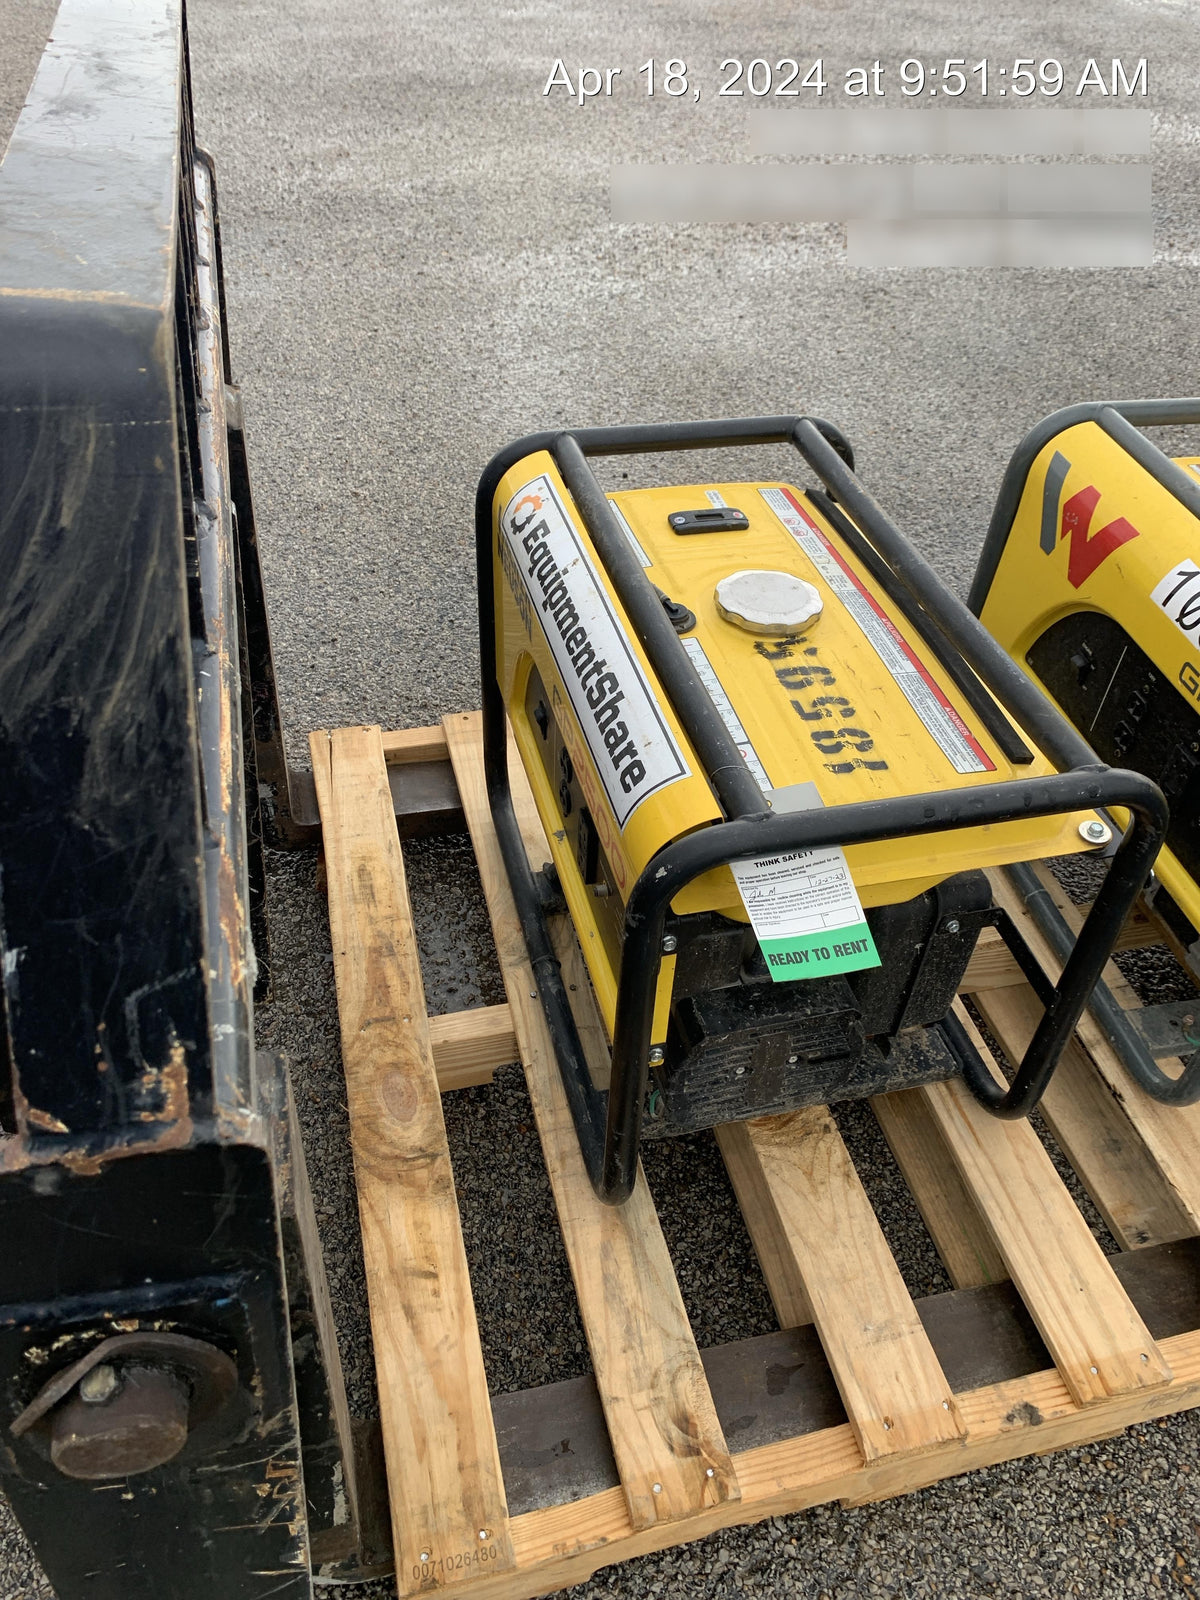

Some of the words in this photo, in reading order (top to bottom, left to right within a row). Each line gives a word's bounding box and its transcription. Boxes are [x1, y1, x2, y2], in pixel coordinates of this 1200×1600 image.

[521, 518, 647, 795] EquipmentShare
[949, 710, 970, 736] DANGER
[754, 858, 781, 869] THINK
[782, 851, 814, 863] SAFETY
[768, 949, 810, 967] READY
[812, 946, 831, 961] TO
[832, 938, 869, 958] RENT
[412, 1544, 498, 1581] 0071026480
